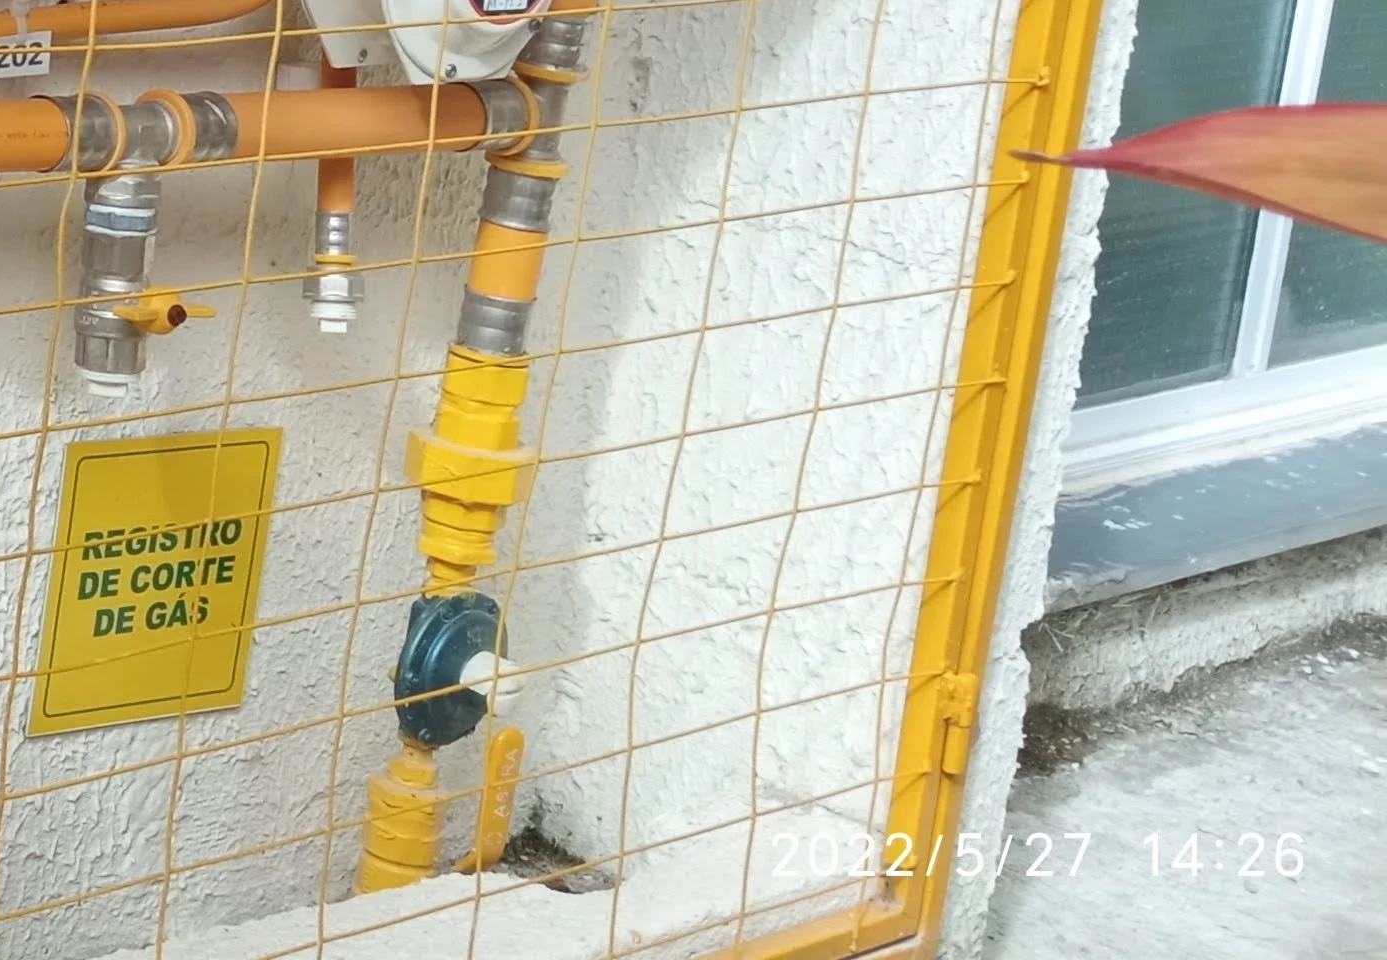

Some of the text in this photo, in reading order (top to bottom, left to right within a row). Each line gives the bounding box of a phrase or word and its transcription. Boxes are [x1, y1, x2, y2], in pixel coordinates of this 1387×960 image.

[81, 517, 244, 561] REGISTRO
[77, 555, 237, 600] DE CORTE
[93, 592, 210, 638] DE GÁS
